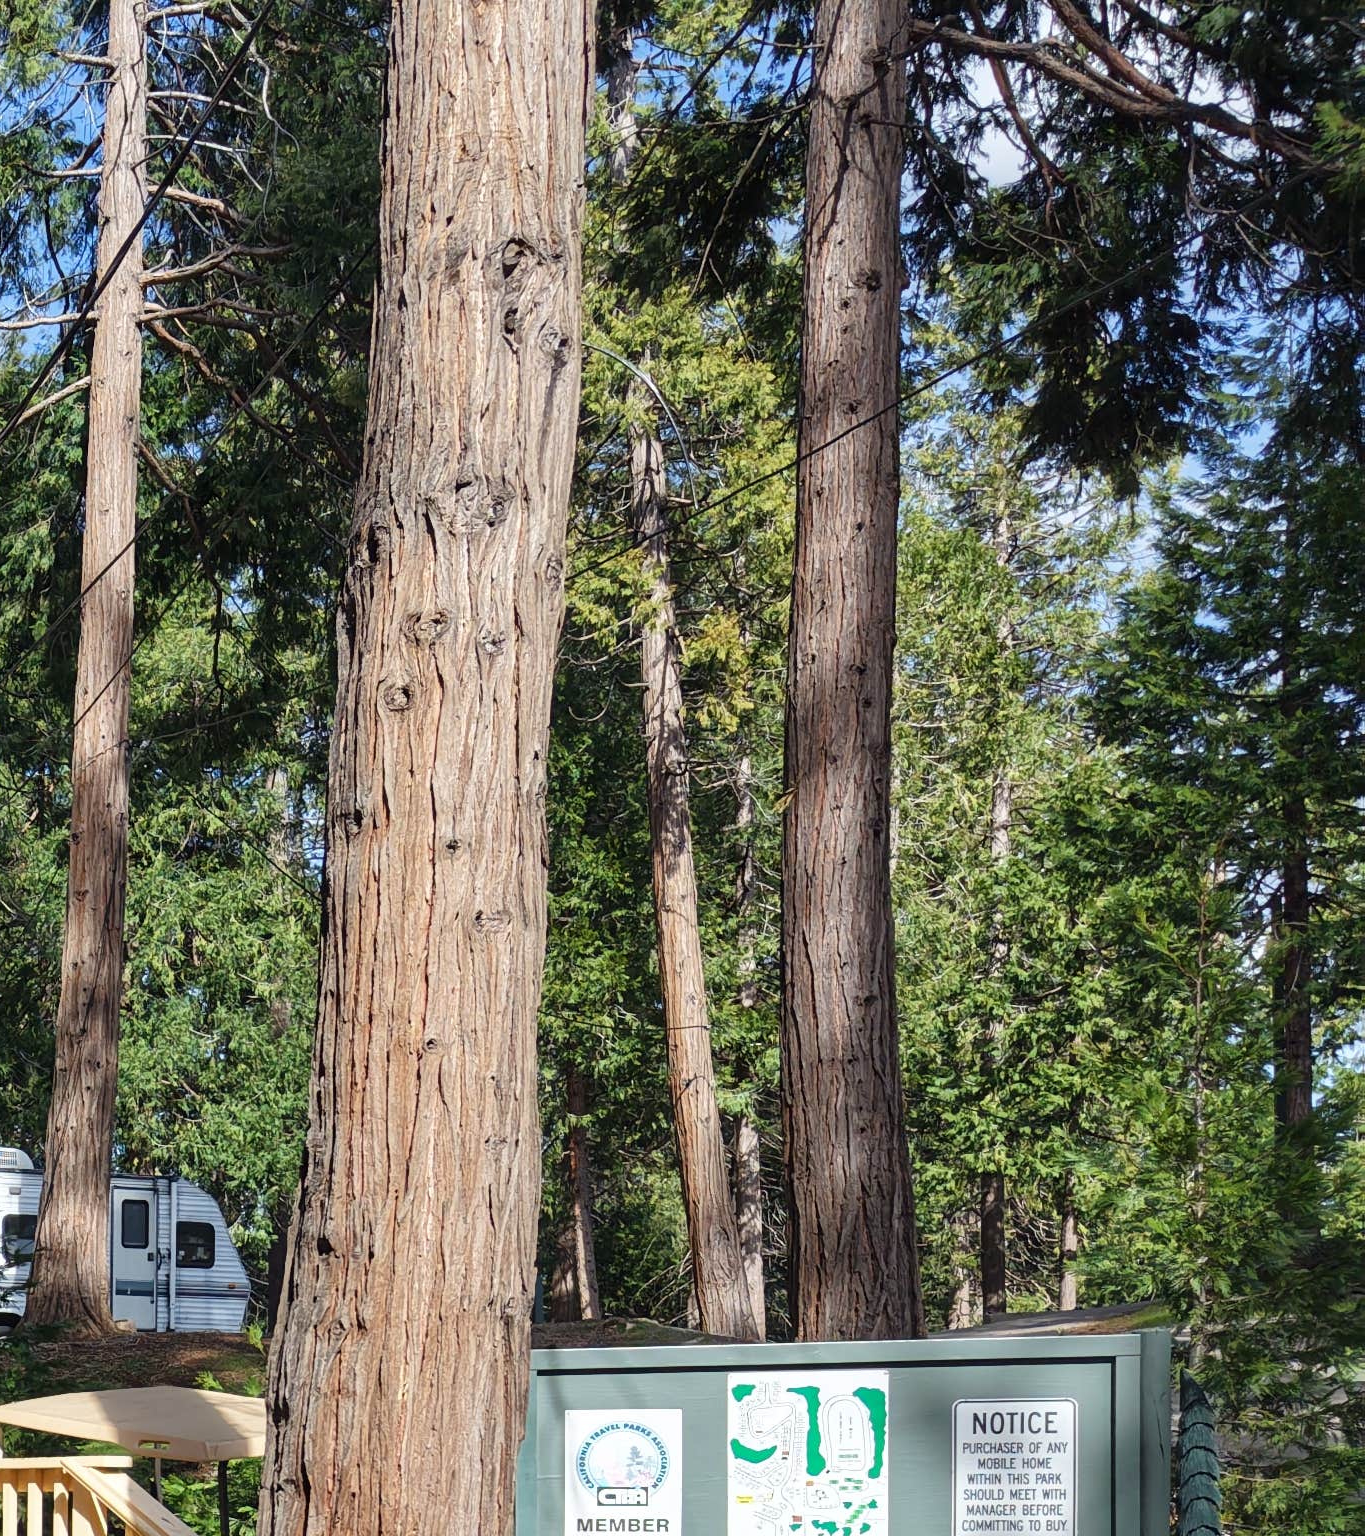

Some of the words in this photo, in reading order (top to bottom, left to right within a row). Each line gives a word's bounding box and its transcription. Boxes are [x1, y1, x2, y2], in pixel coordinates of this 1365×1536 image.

[972, 1411, 1058, 1435] NOTICE
[962, 1442, 1024, 1454] PURCHASER
[1029, 1441, 1043, 1454] OF
[1047, 1441, 1068, 1454] ANY
[579, 1441, 594, 1489] CALIFORNIA
[590, 1423, 621, 1441] TRAVEL
[623, 1423, 652, 1437] PARKS
[651, 1436, 668, 1489] ASSOCIATION
[977, 1457, 1017, 1470] MOBILE
[1022, 1457, 1052, 1469] HOME
[967, 1473, 1002, 1485] WITHIN
[1007, 1473, 1030, 1485] THIS
[1035, 1473, 1062, 1485] PARK
[963, 1488, 1004, 1501] SHOULD
[1010, 1488, 1037, 1501] MEET
[1042, 1488, 1067, 1501] WITH
[966, 1504, 1017, 1516] MANAGER
[1022, 1504, 1063, 1516] BEFORE
[576, 1518, 670, 1532] MEMBER
[962, 1519, 1024, 1532] COMMITTING
[1029, 1519, 1041, 1531] TO
